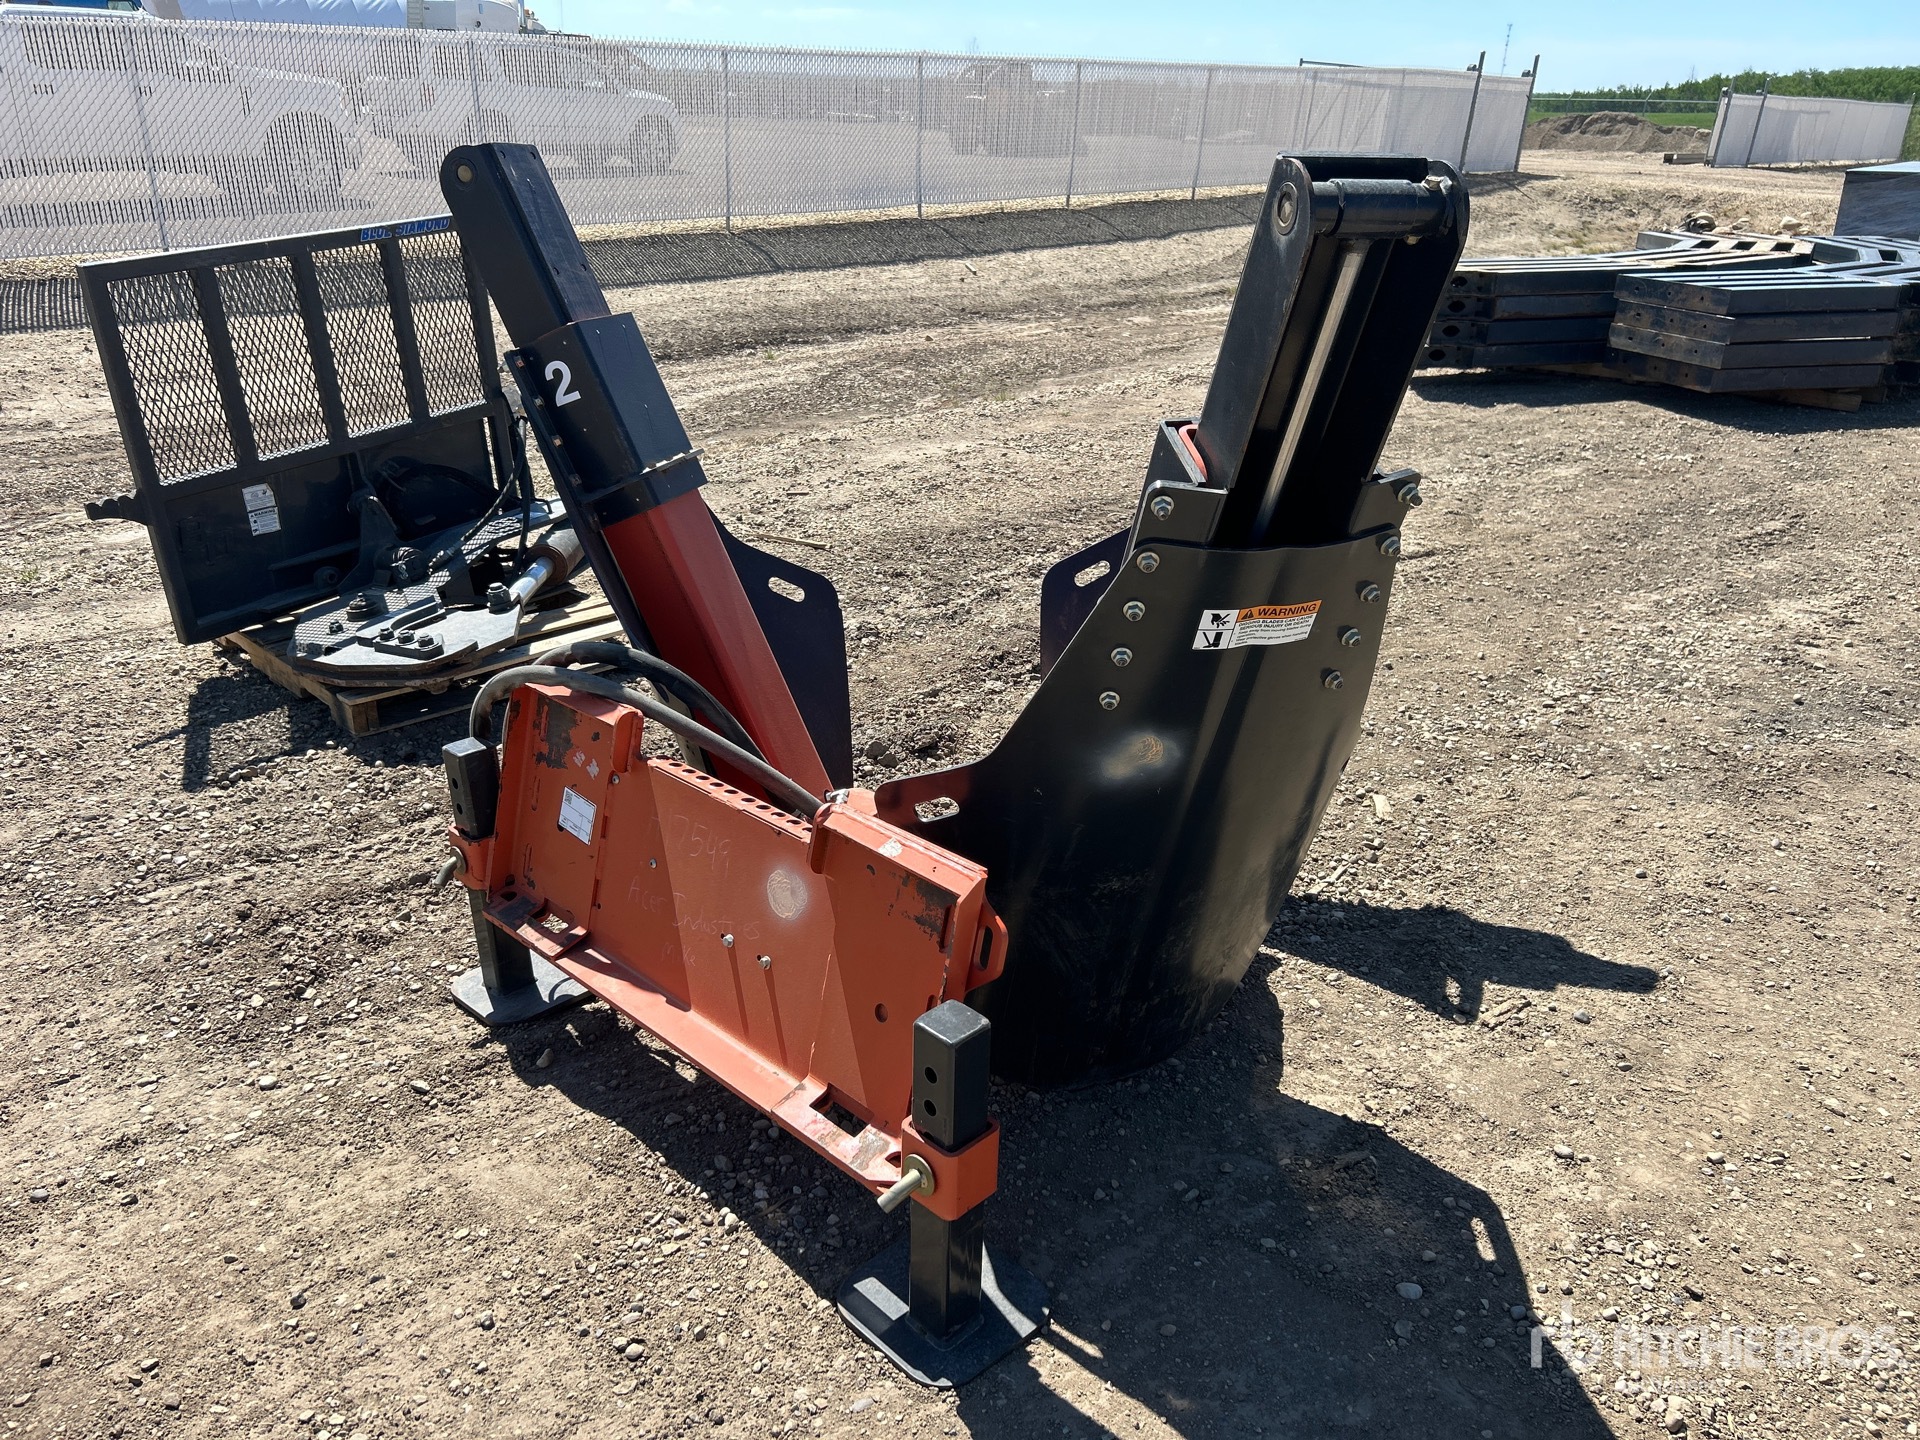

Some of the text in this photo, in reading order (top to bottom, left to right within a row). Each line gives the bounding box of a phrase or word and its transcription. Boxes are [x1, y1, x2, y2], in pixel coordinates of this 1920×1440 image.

[361, 219, 450, 241] BLUE DIAMOND
[545, 360, 581, 407] 2
[1258, 604, 1316, 616] WARNING
